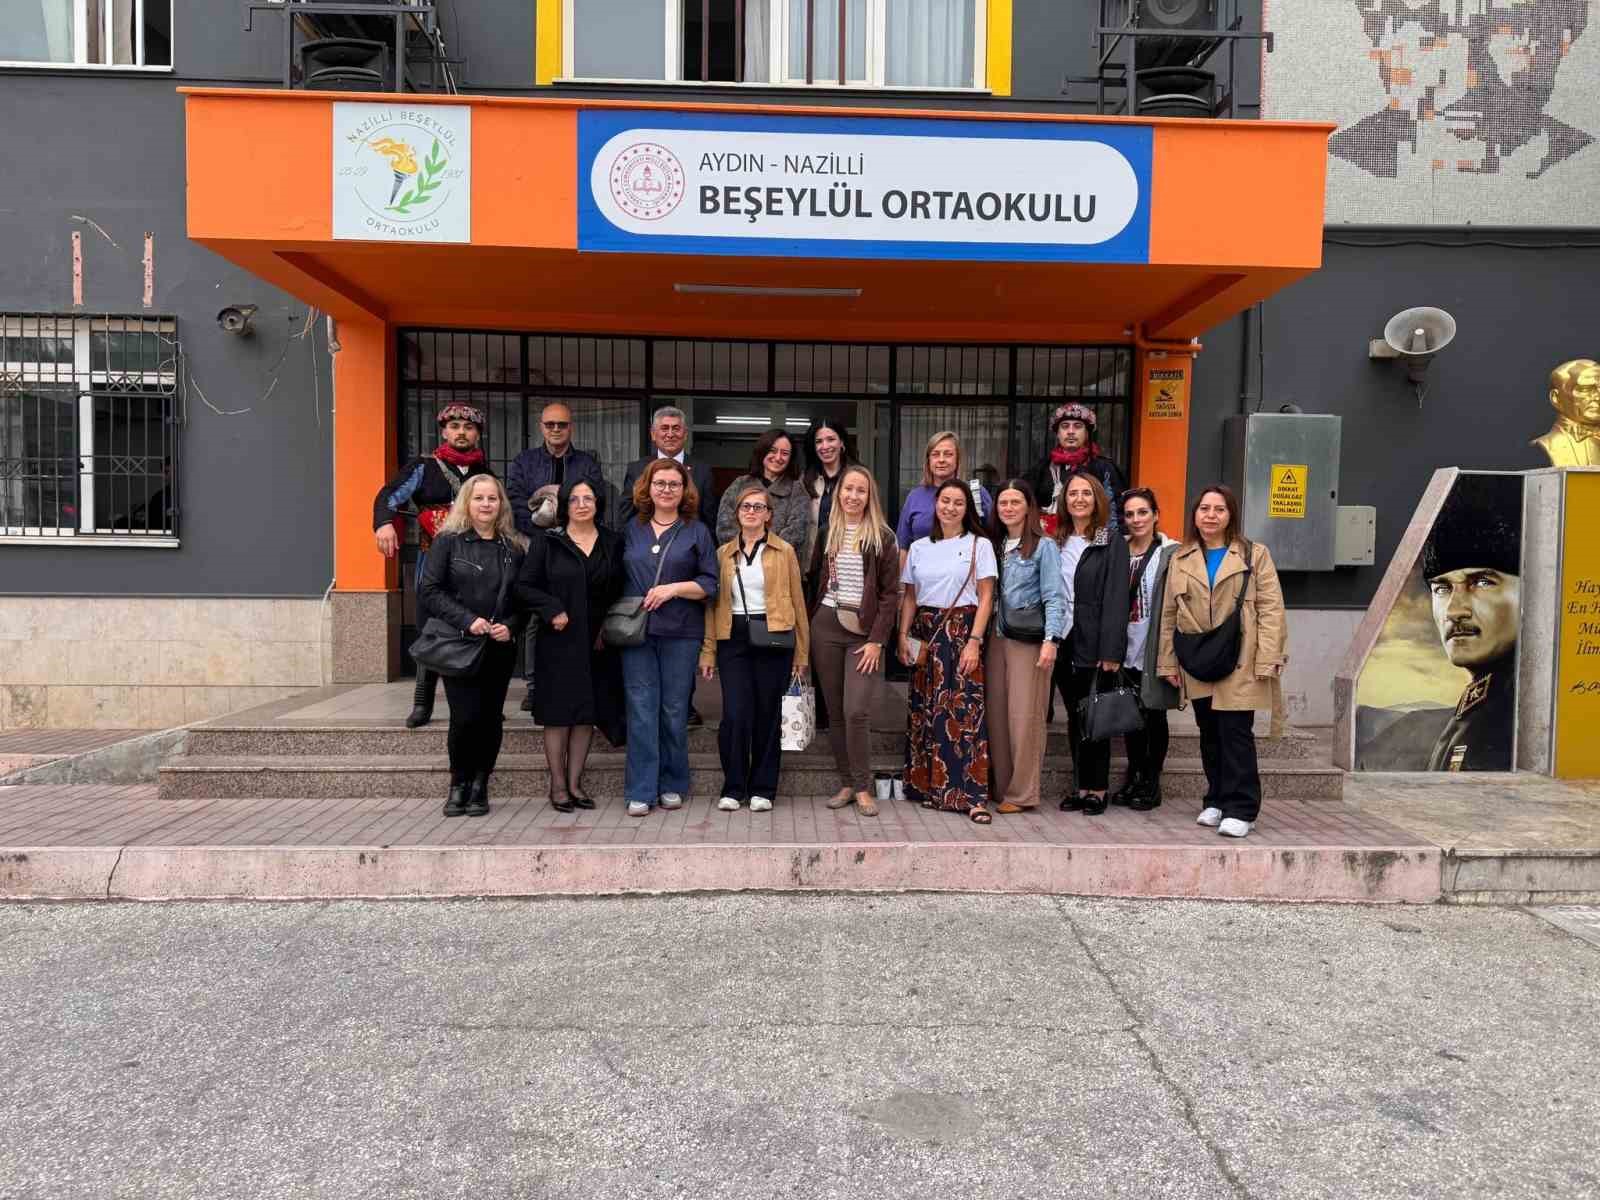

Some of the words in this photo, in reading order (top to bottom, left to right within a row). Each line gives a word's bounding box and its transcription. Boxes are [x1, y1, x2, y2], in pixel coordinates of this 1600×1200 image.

[699, 152, 764, 173] AYDIN
[784, 152, 864, 175] NAZİLLİ
[699, 181, 873, 223] BEŞEYLÜL
[881, 189, 1097, 223] ORTAOKULU
[366, 216, 440, 236] ORTAOKULU
